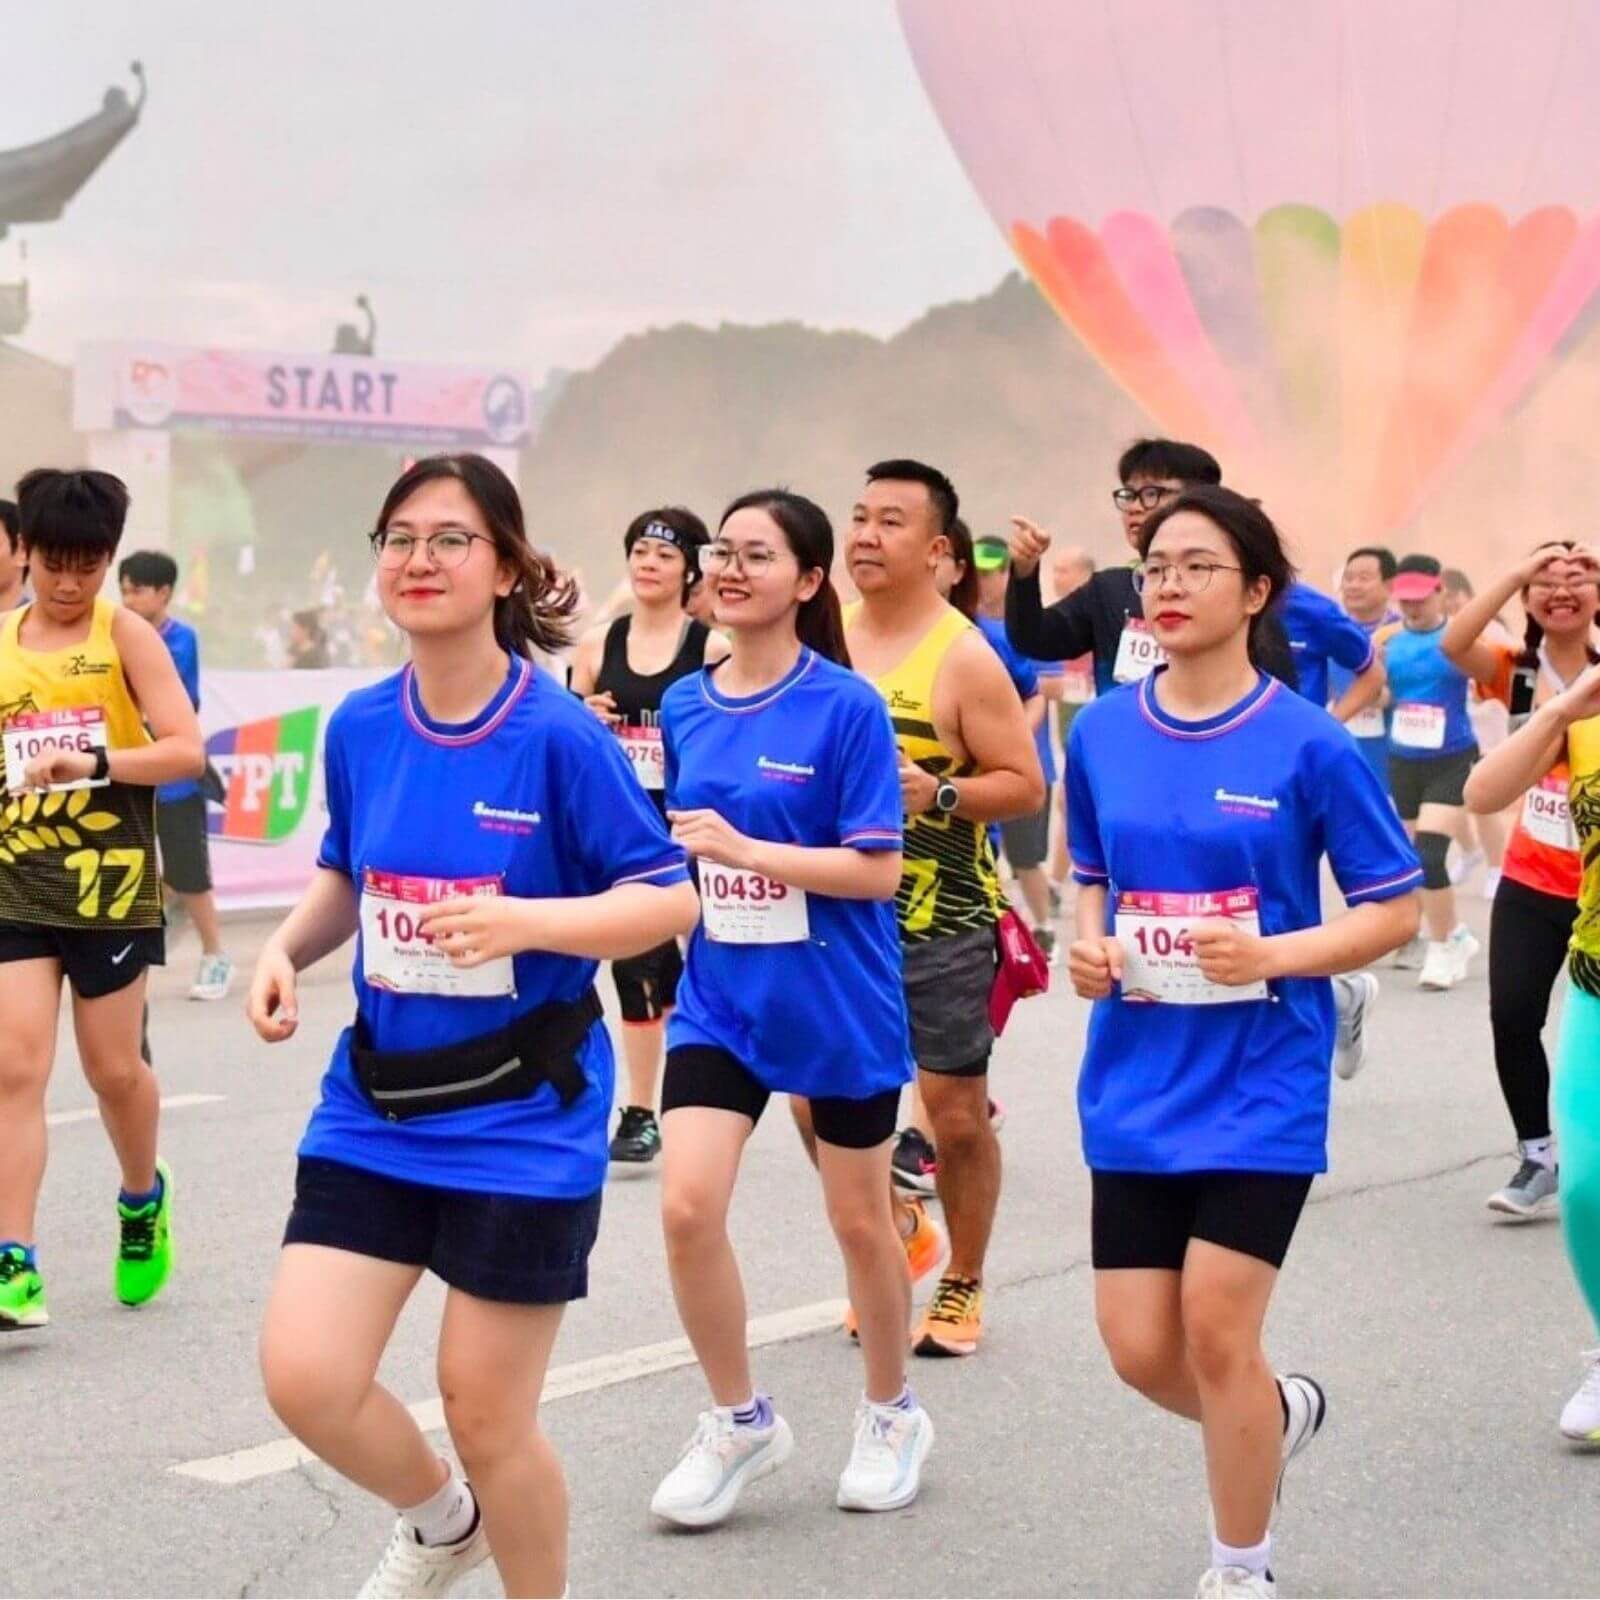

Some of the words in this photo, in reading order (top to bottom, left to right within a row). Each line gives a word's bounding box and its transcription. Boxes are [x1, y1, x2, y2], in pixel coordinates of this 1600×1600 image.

[266, 365, 398, 414] START
[63, 848, 145, 919] 17
[703, 872, 788, 901] 10435
[375, 907, 436, 945] 104
[1133, 926, 1194, 957] 104
